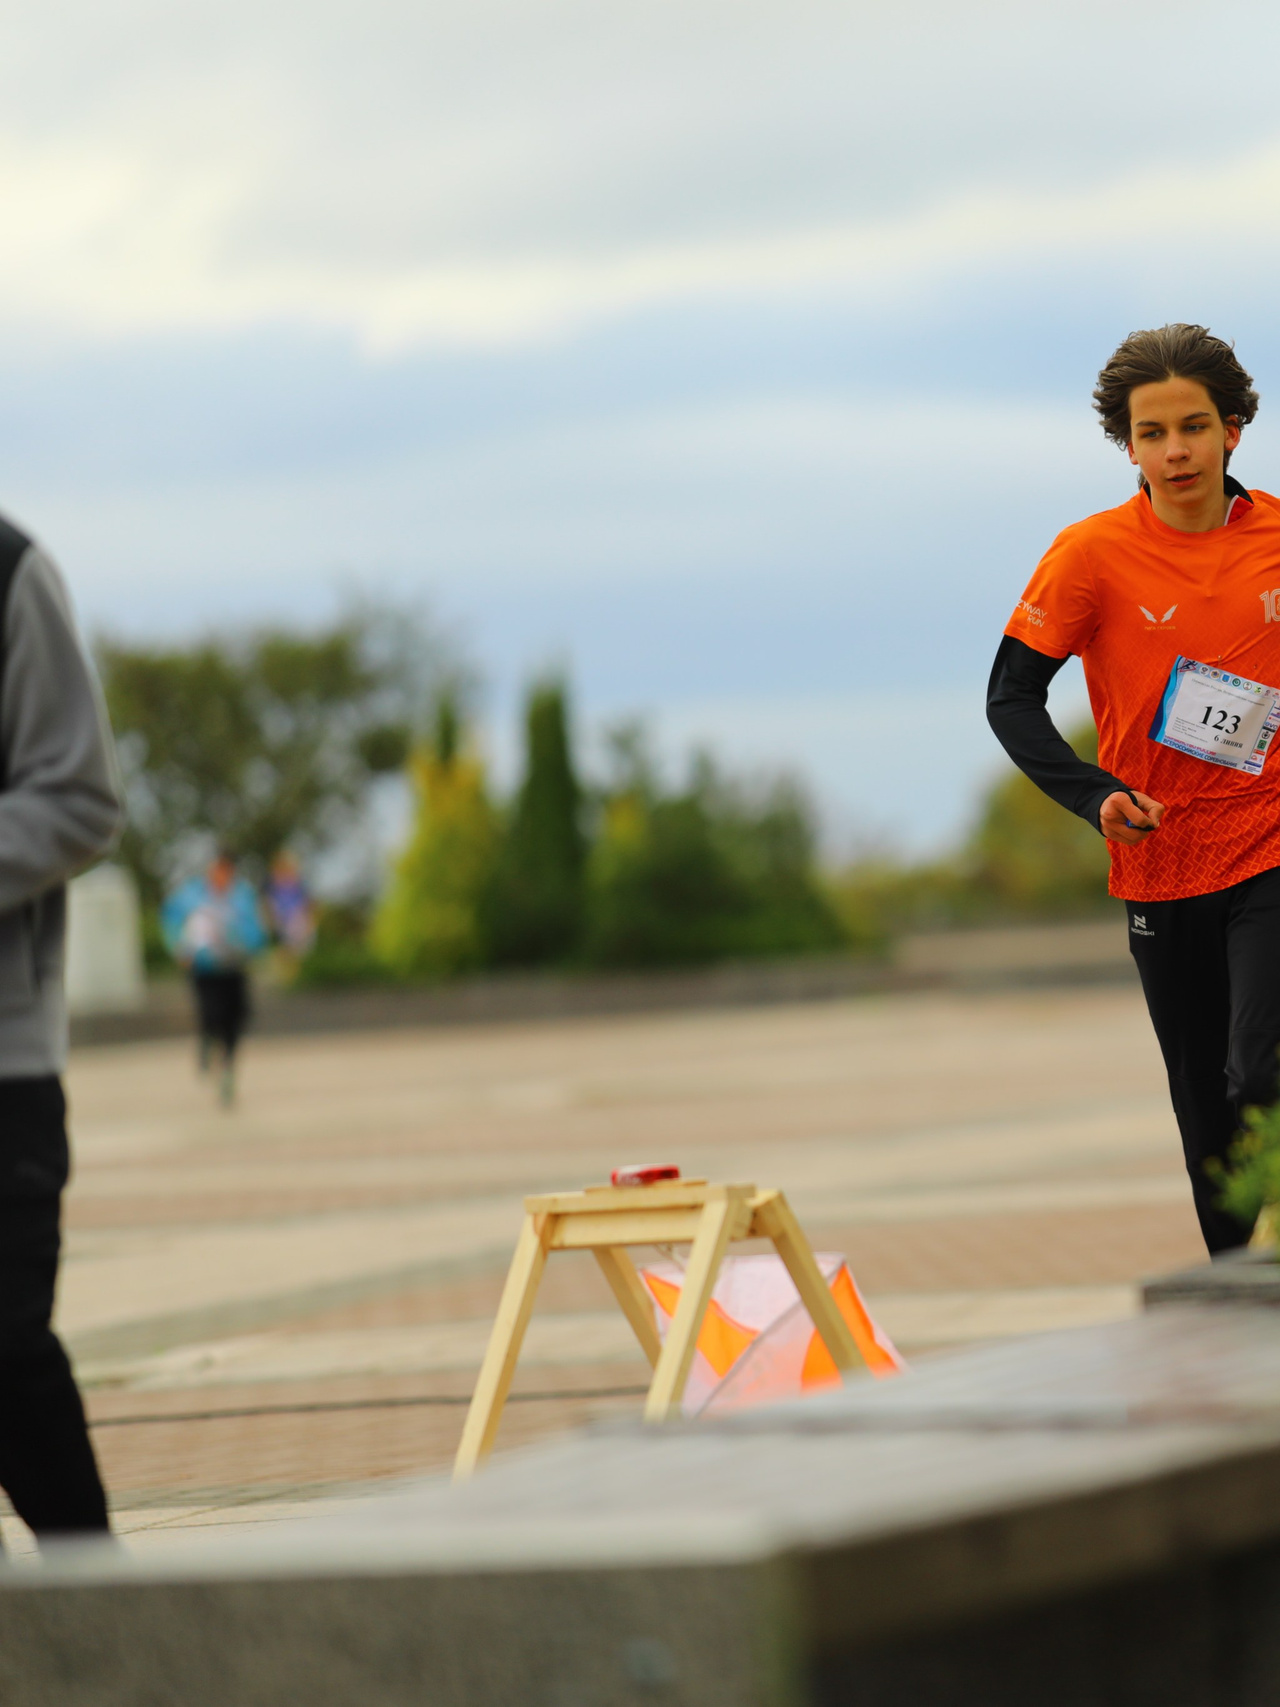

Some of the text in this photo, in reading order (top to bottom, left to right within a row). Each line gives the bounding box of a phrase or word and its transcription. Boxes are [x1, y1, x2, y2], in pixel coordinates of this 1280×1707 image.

[1027, 614, 1045, 628] RUN
[1200, 706, 1242, 735] 123
[1213, 734, 1220, 742] 6
